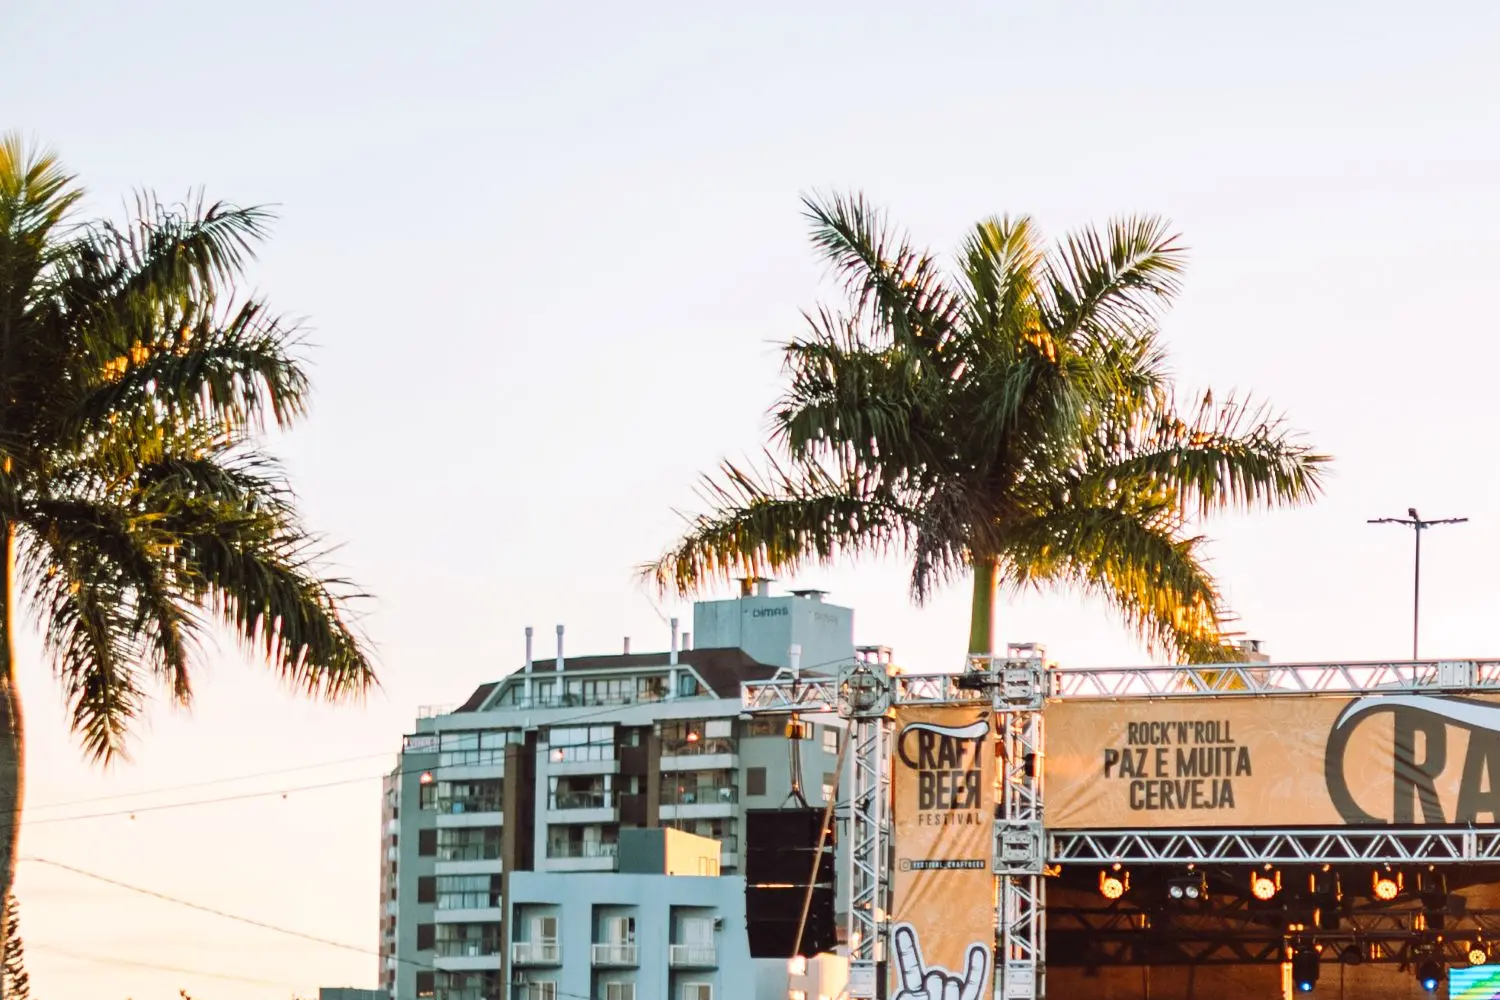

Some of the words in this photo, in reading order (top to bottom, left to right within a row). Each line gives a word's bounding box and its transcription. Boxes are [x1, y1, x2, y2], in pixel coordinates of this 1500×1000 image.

[897, 719, 990, 770] CRAFT
[1128, 720, 1235, 745] ROCK'N'ROLL
[1104, 748, 1149, 778] PAZ
[1155, 748, 1169, 778] E
[1176, 746, 1252, 777] MUITA
[1129, 778, 1236, 810] CERVEJA
[918, 812, 983, 826] FESTIVAL
